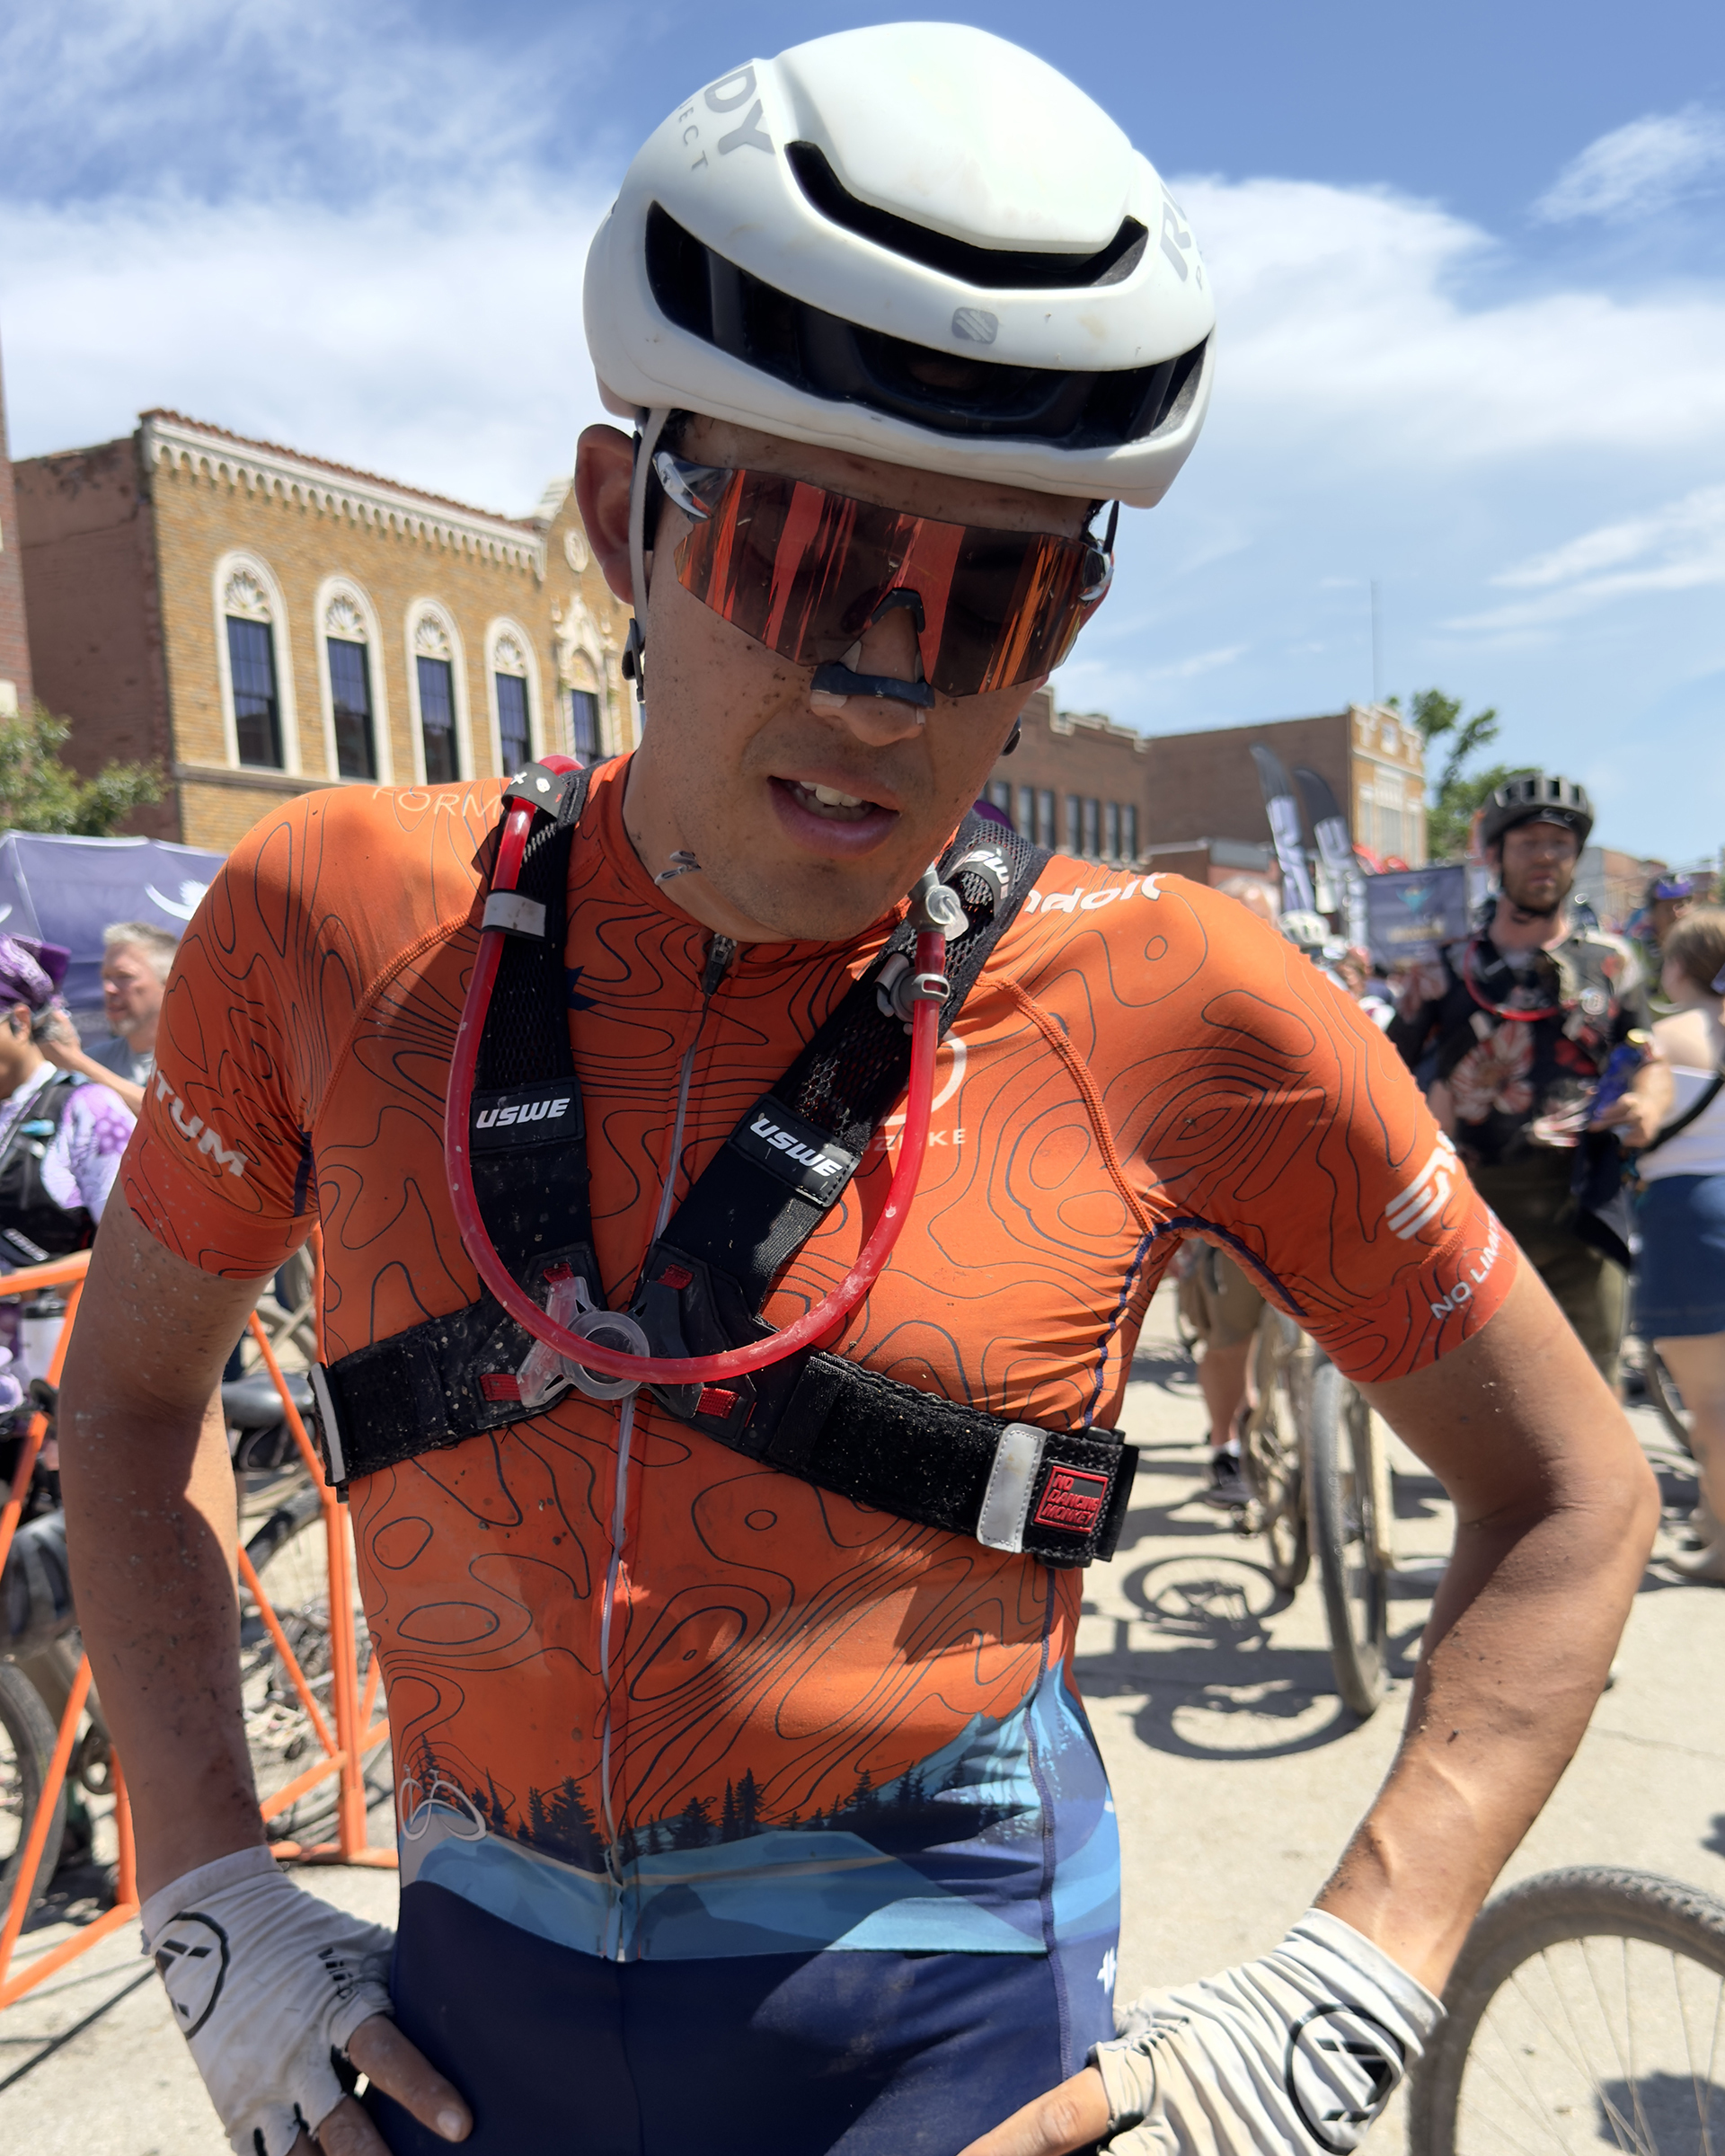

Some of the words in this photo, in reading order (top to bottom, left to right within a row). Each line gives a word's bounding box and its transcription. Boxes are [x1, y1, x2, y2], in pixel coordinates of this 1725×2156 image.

[704, 59, 776, 155] DY
[150, 1058, 249, 1178] TUM
[476, 1097, 571, 1129] USWE
[749, 1117, 844, 1179] USWE
[1430, 1281, 1472, 1321] NO
[1047, 1489, 1101, 1512] DANCING
[1052, 1474, 1075, 1491] NO
[1041, 1503, 1095, 1525] MONKEY
